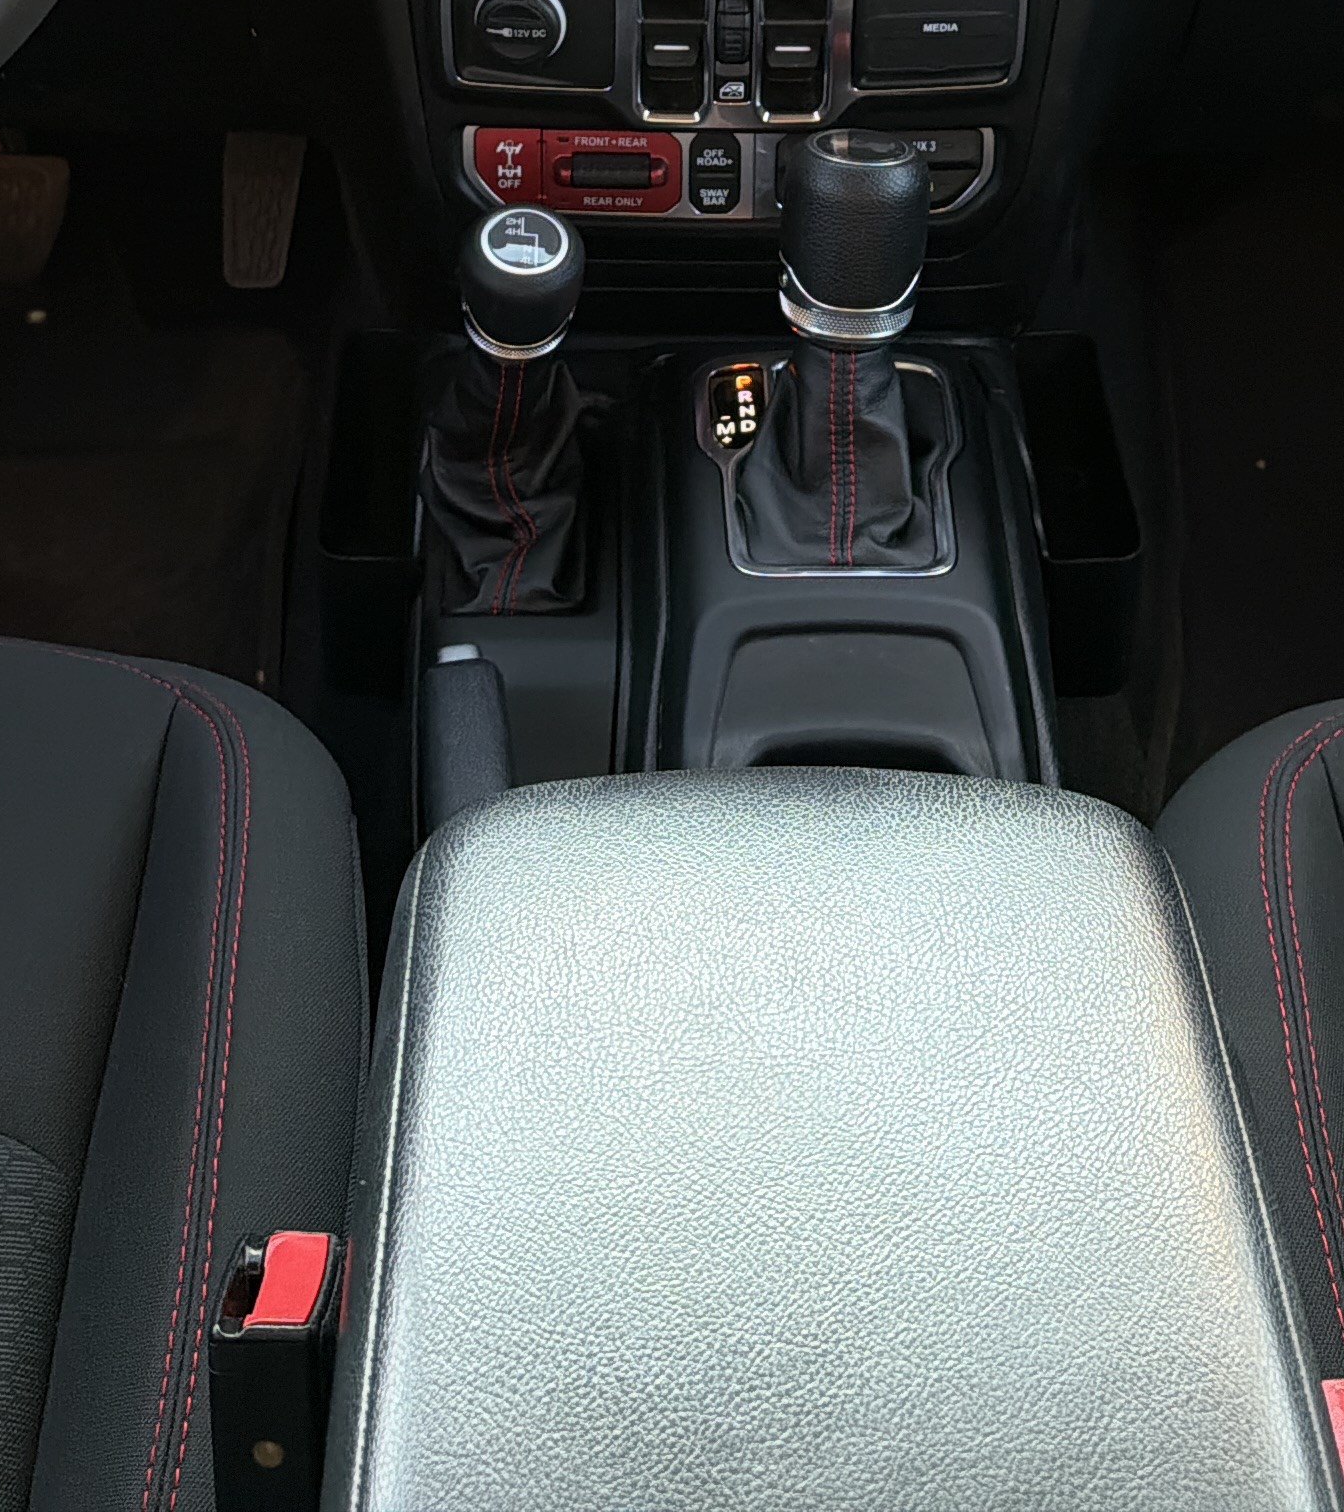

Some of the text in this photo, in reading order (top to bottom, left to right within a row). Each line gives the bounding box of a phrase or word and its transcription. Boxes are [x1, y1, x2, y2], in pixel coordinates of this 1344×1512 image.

[513, 29, 547, 38] 12V DC
[922, 23, 959, 33] MEDIA
[574, 136, 648, 148] FRONT REAR
[929, 141, 937, 152] 3
[703, 148, 725, 158] OFF
[497, 179, 521, 188] OFF
[699, 188, 730, 199] SWAY
[583, 196, 644, 207] REAR ONLY
[702, 197, 726, 206] BAR
[505, 217, 521, 226] 2H
[736, 375, 752, 390] P
[737, 390, 754, 404] R
[739, 404, 756, 418] N
[716, 421, 736, 435] M
[740, 419, 757, 433] D
